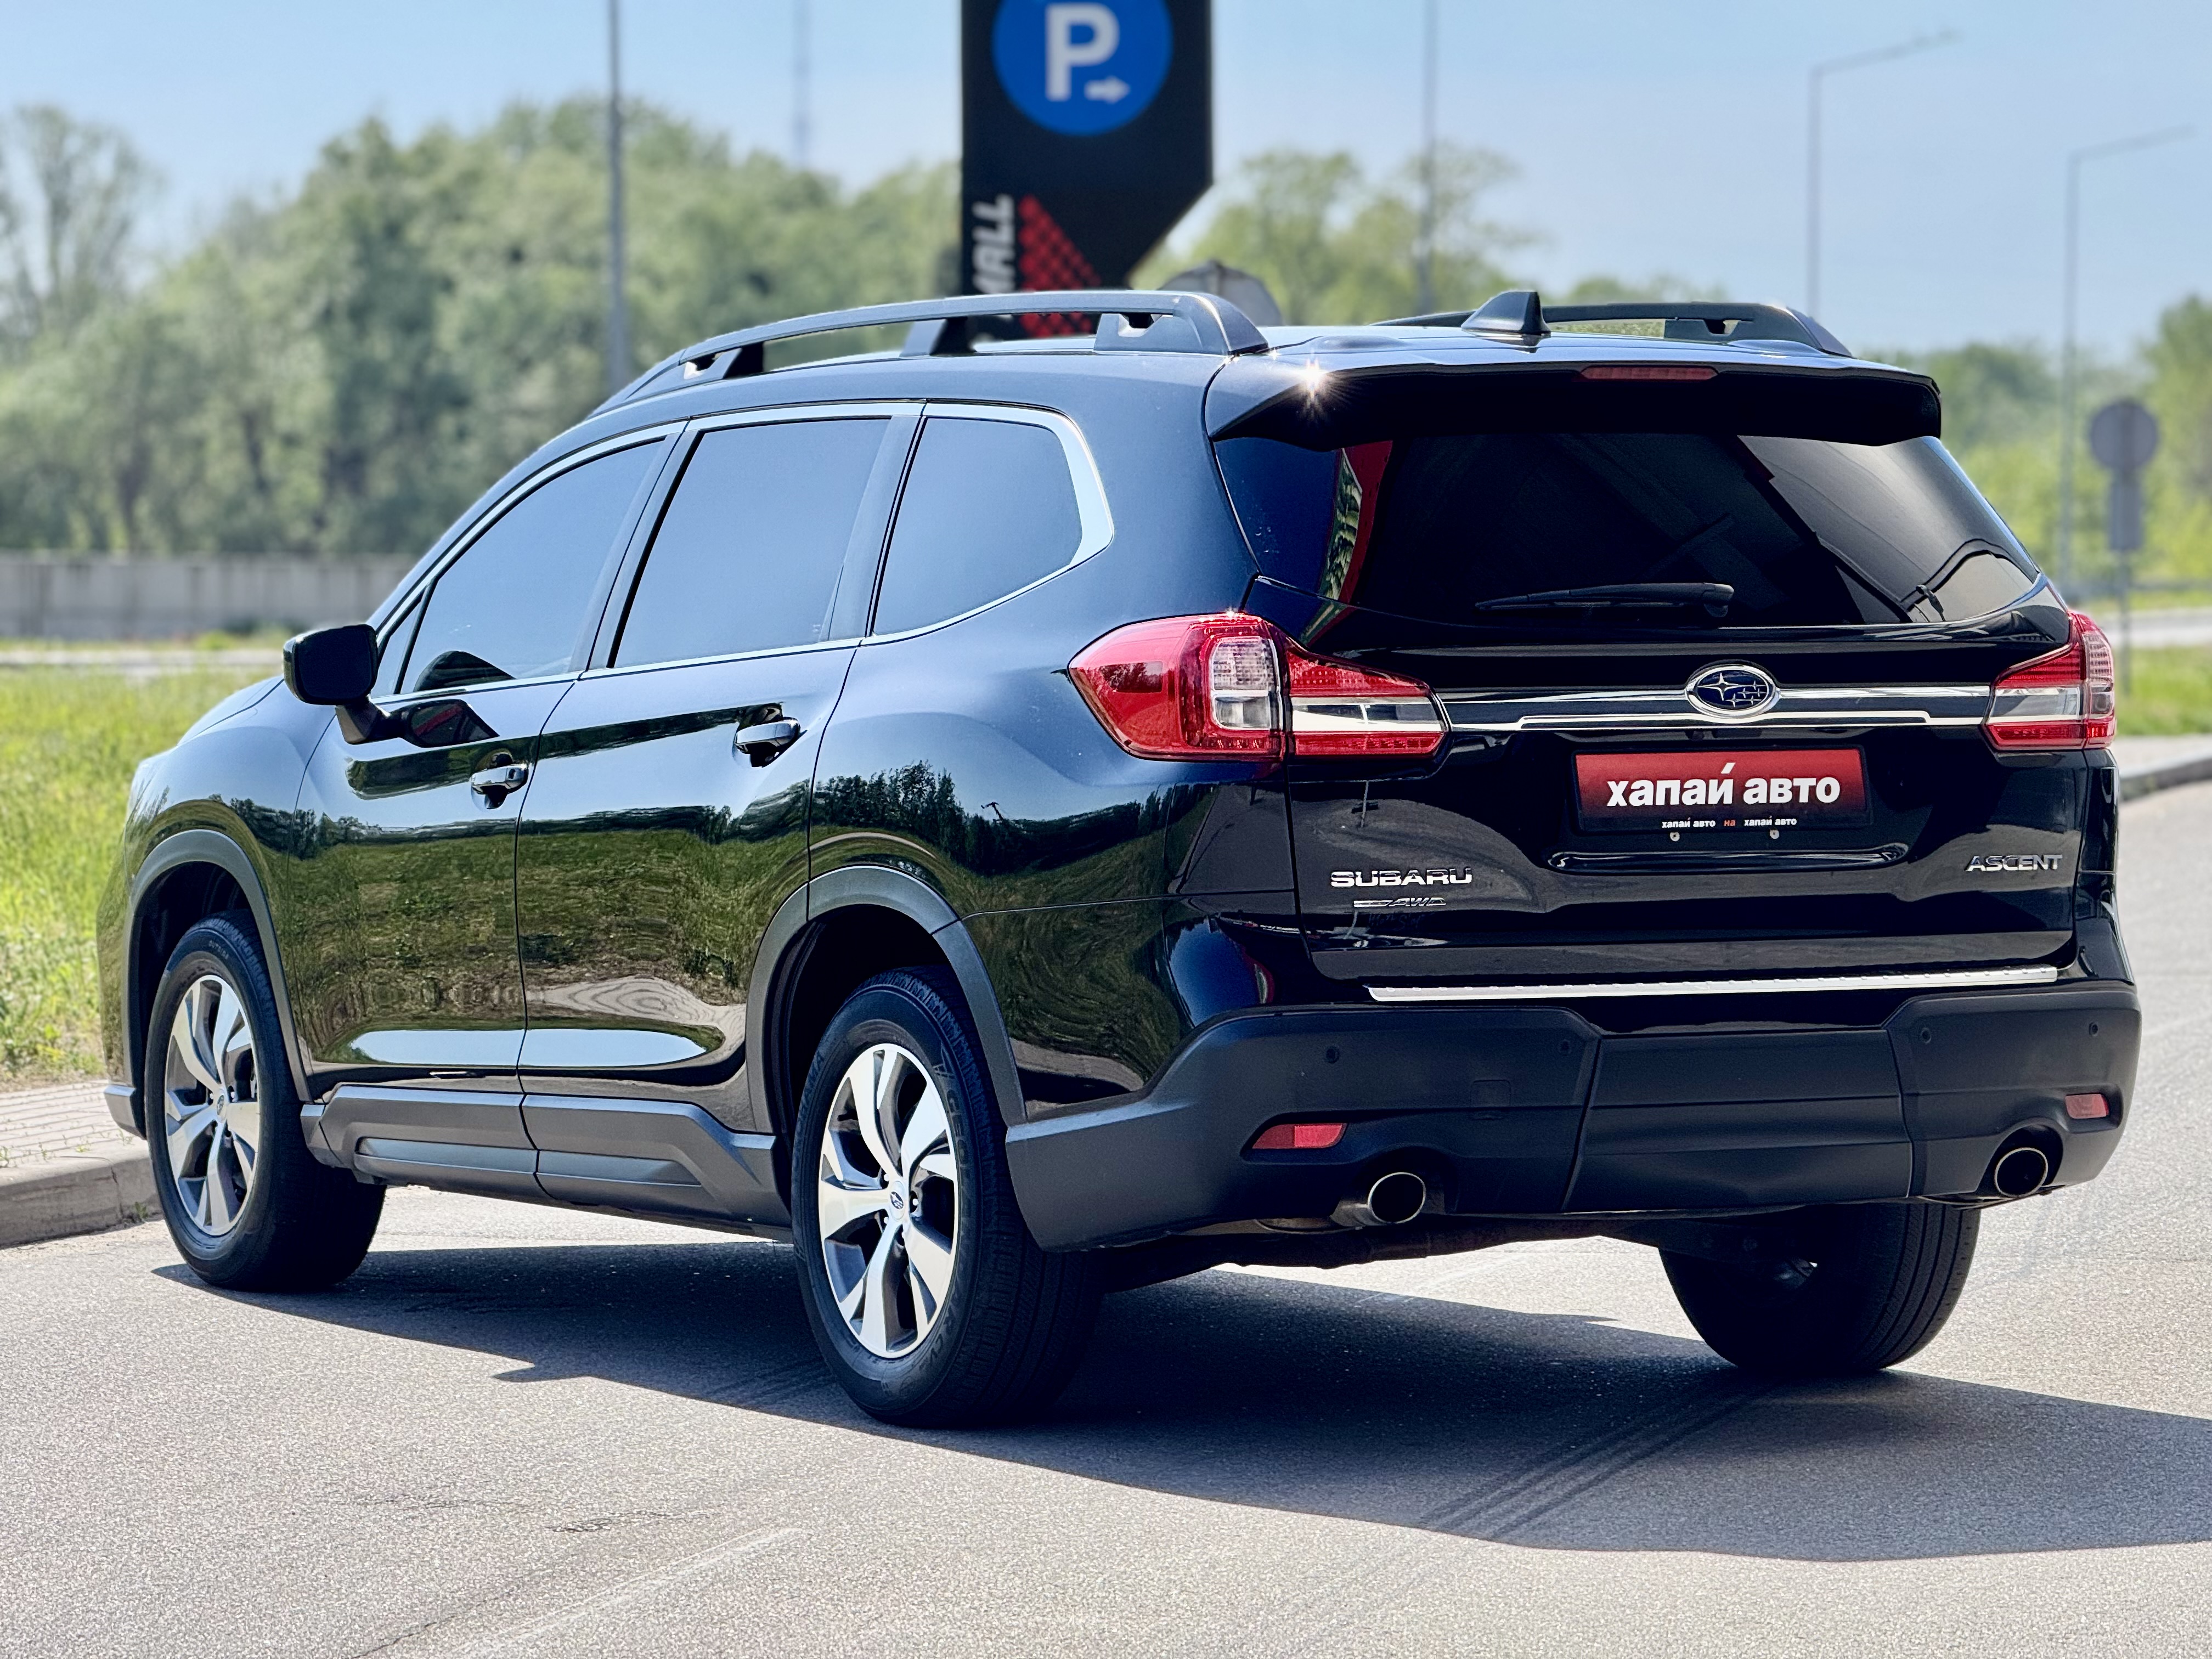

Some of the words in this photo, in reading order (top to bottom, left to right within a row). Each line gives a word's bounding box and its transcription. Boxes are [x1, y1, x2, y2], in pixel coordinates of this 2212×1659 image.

[1045, 2, 1120, 102] P
[1743, 776, 1841, 804] авто
[1692, 820, 1716, 828] авто
[1965, 854, 2063, 872] ASCENT
[1330, 868, 1472, 887] SUBARU
[1388, 898, 1447, 907] AWD
